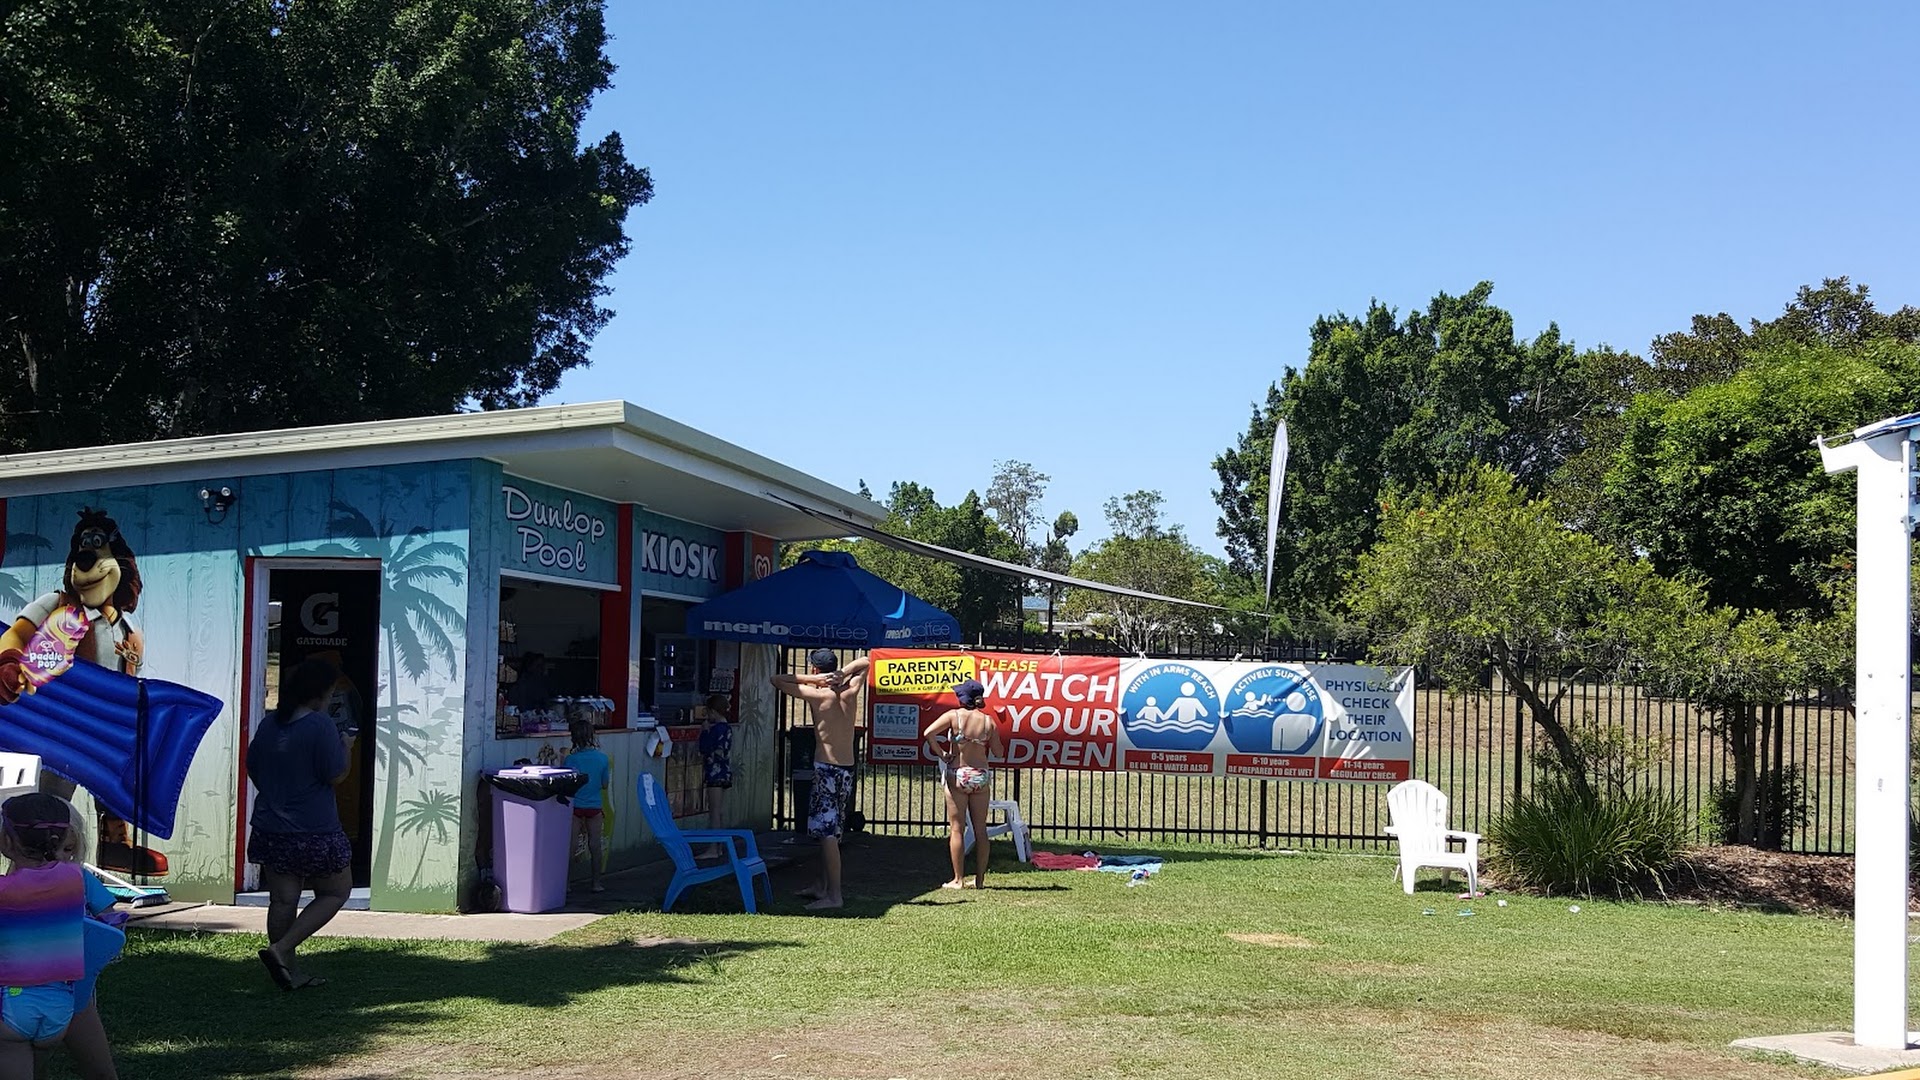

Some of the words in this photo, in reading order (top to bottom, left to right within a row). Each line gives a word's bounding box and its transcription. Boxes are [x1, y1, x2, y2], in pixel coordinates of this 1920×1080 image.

[502, 486, 605, 544] Dunlop
[518, 526, 586, 572] Pool
[641, 531, 719, 583] KIOSK
[300, 592, 339, 635] G
[296, 637, 348, 647] GATORADE
[888, 660, 963, 673] PARENTS/
[980, 659, 1039, 673] PLEASE
[879, 671, 972, 686] GUARDIANS
[1128, 673, 1150, 694] WITH
[1149, 667, 1161, 677] IN
[1163, 665, 1191, 676] ARMS
[1191, 671, 1216, 699] REACH
[980, 671, 1117, 703] WATCH
[1234, 669, 1273, 695] ACTIVELY
[1274, 669, 1318, 702] SUPEVISE
[1342, 697, 1390, 709] CHECK
[876, 704, 917, 715] KEEP
[876, 715, 916, 725] WATCH
[1006, 705, 1116, 736] YOUR
[1345, 714, 1386, 725] THEIR
[1329, 730, 1402, 742] LOCATION
[922, 735, 1114, 768] CLDREN
[1151, 752, 1164, 761] 0-5
[1165, 753, 1187, 762] years
[1129, 761, 1140, 769] BE
[1140, 762, 1148, 770] IN
[1149, 762, 1163, 771] THE
[1164, 763, 1188, 771] WATER
[1189, 763, 1208, 772] ALSO
[1252, 756, 1268, 765] 6-10
[1269, 757, 1290, 766] years
[1343, 760, 1361, 769] 11-14
[1363, 761, 1385, 770] years
[1228, 765, 1237, 773] BE
[1237, 766, 1273, 775] PREPARED
[1273, 767, 1283, 776] TO
[1284, 767, 1297, 776] GET
[1297, 768, 1314, 777] WET
[1330, 769, 1370, 779] REGULARLY
[1371, 770, 1397, 780] CHECK
